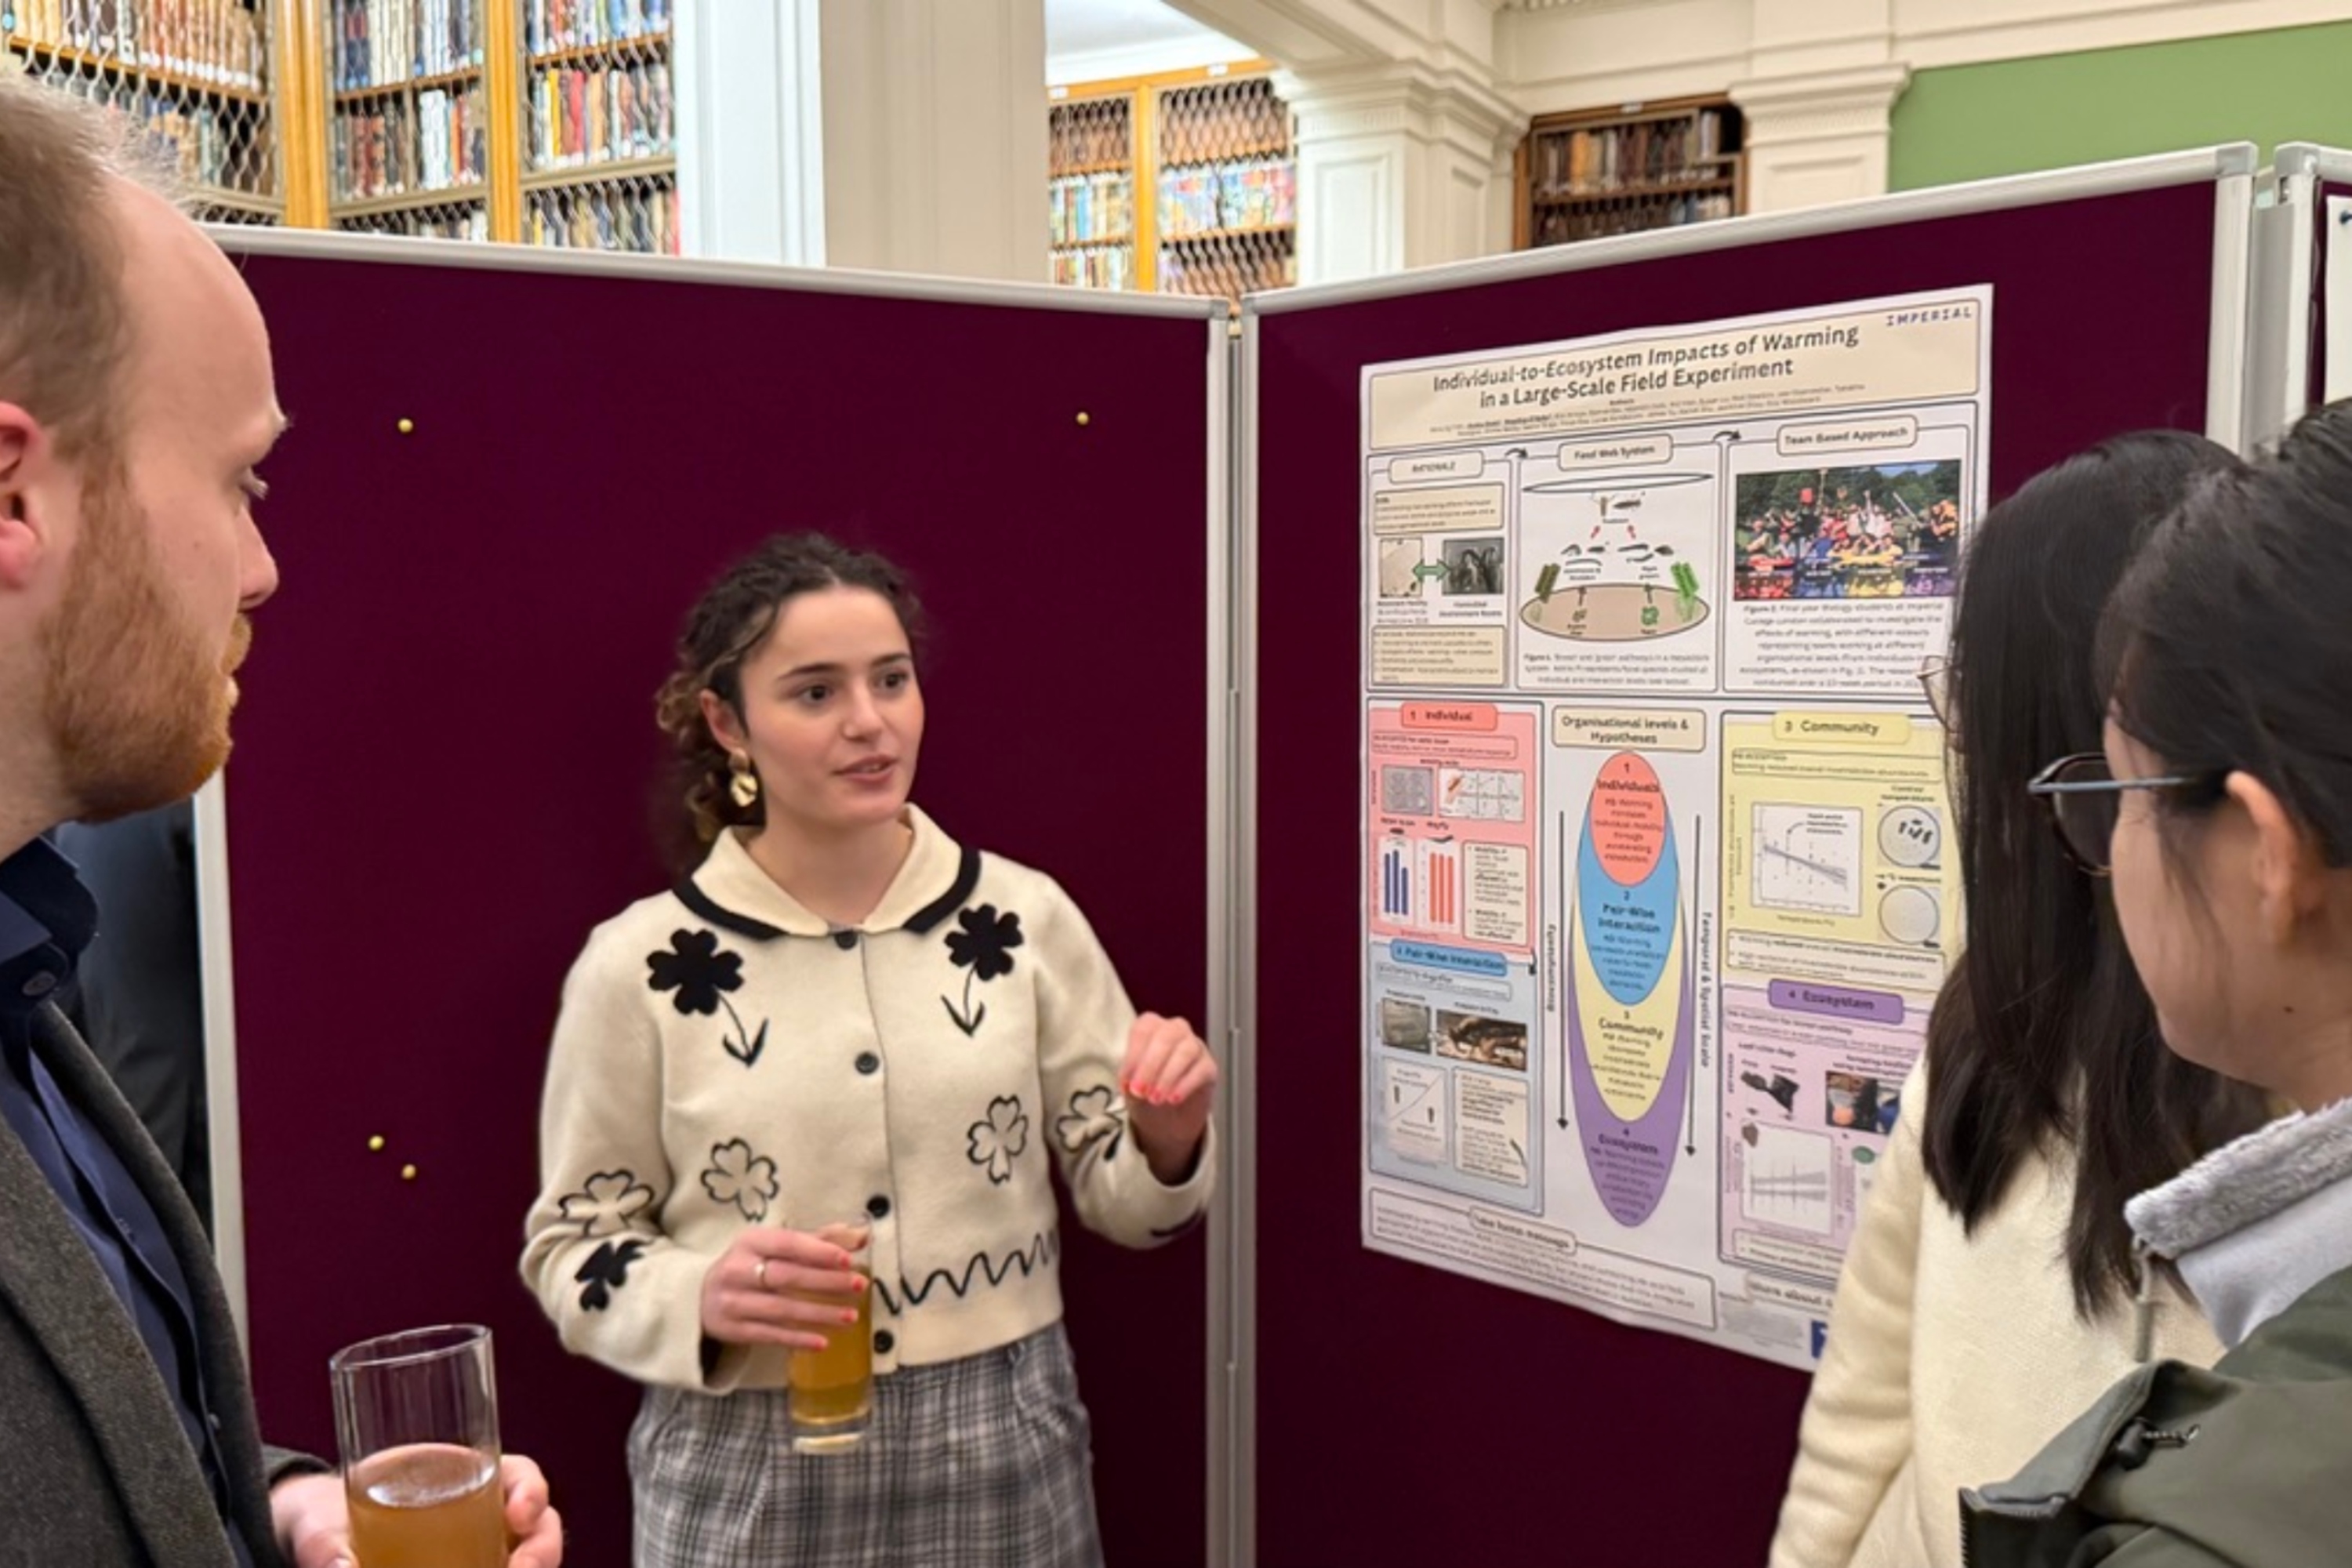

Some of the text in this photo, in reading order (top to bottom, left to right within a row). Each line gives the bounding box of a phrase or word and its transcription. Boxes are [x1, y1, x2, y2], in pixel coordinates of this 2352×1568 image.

[1886, 307, 1972, 326] IMPERIAL
[1433, 325, 1860, 392] Individual-to-Ecosystem Impacts of Warming
[1479, 358, 1795, 409] in a Large-Scale Field Experiment
[1784, 426, 1909, 446] Team Based Approach
[1574, 449, 1596, 460] Food
[1620, 445, 1656, 459] System
[1410, 710, 1473, 722] 1 Individual
[1561, 715, 1689, 730] Organisational levels &
[1784, 719, 1881, 737] 3 Community
[1590, 731, 1658, 744] Hypotheses
[1624, 762, 1631, 774] 1
[1596, 779, 1661, 793] Individuals
[1624, 891, 1631, 902] 2
[1602, 904, 1656, 918] Pair-Wise
[1598, 918, 1661, 934] Interaction
[1700, 912, 1712, 971] Temporal
[1802, 989, 1875, 1011] Ecosystem
[1699, 987, 1712, 1033] Spatial
[1598, 1017, 1664, 1041] Community
[1700, 1033, 1711, 1068] Scale
[1598, 1133, 1659, 1156] Ecosystem
